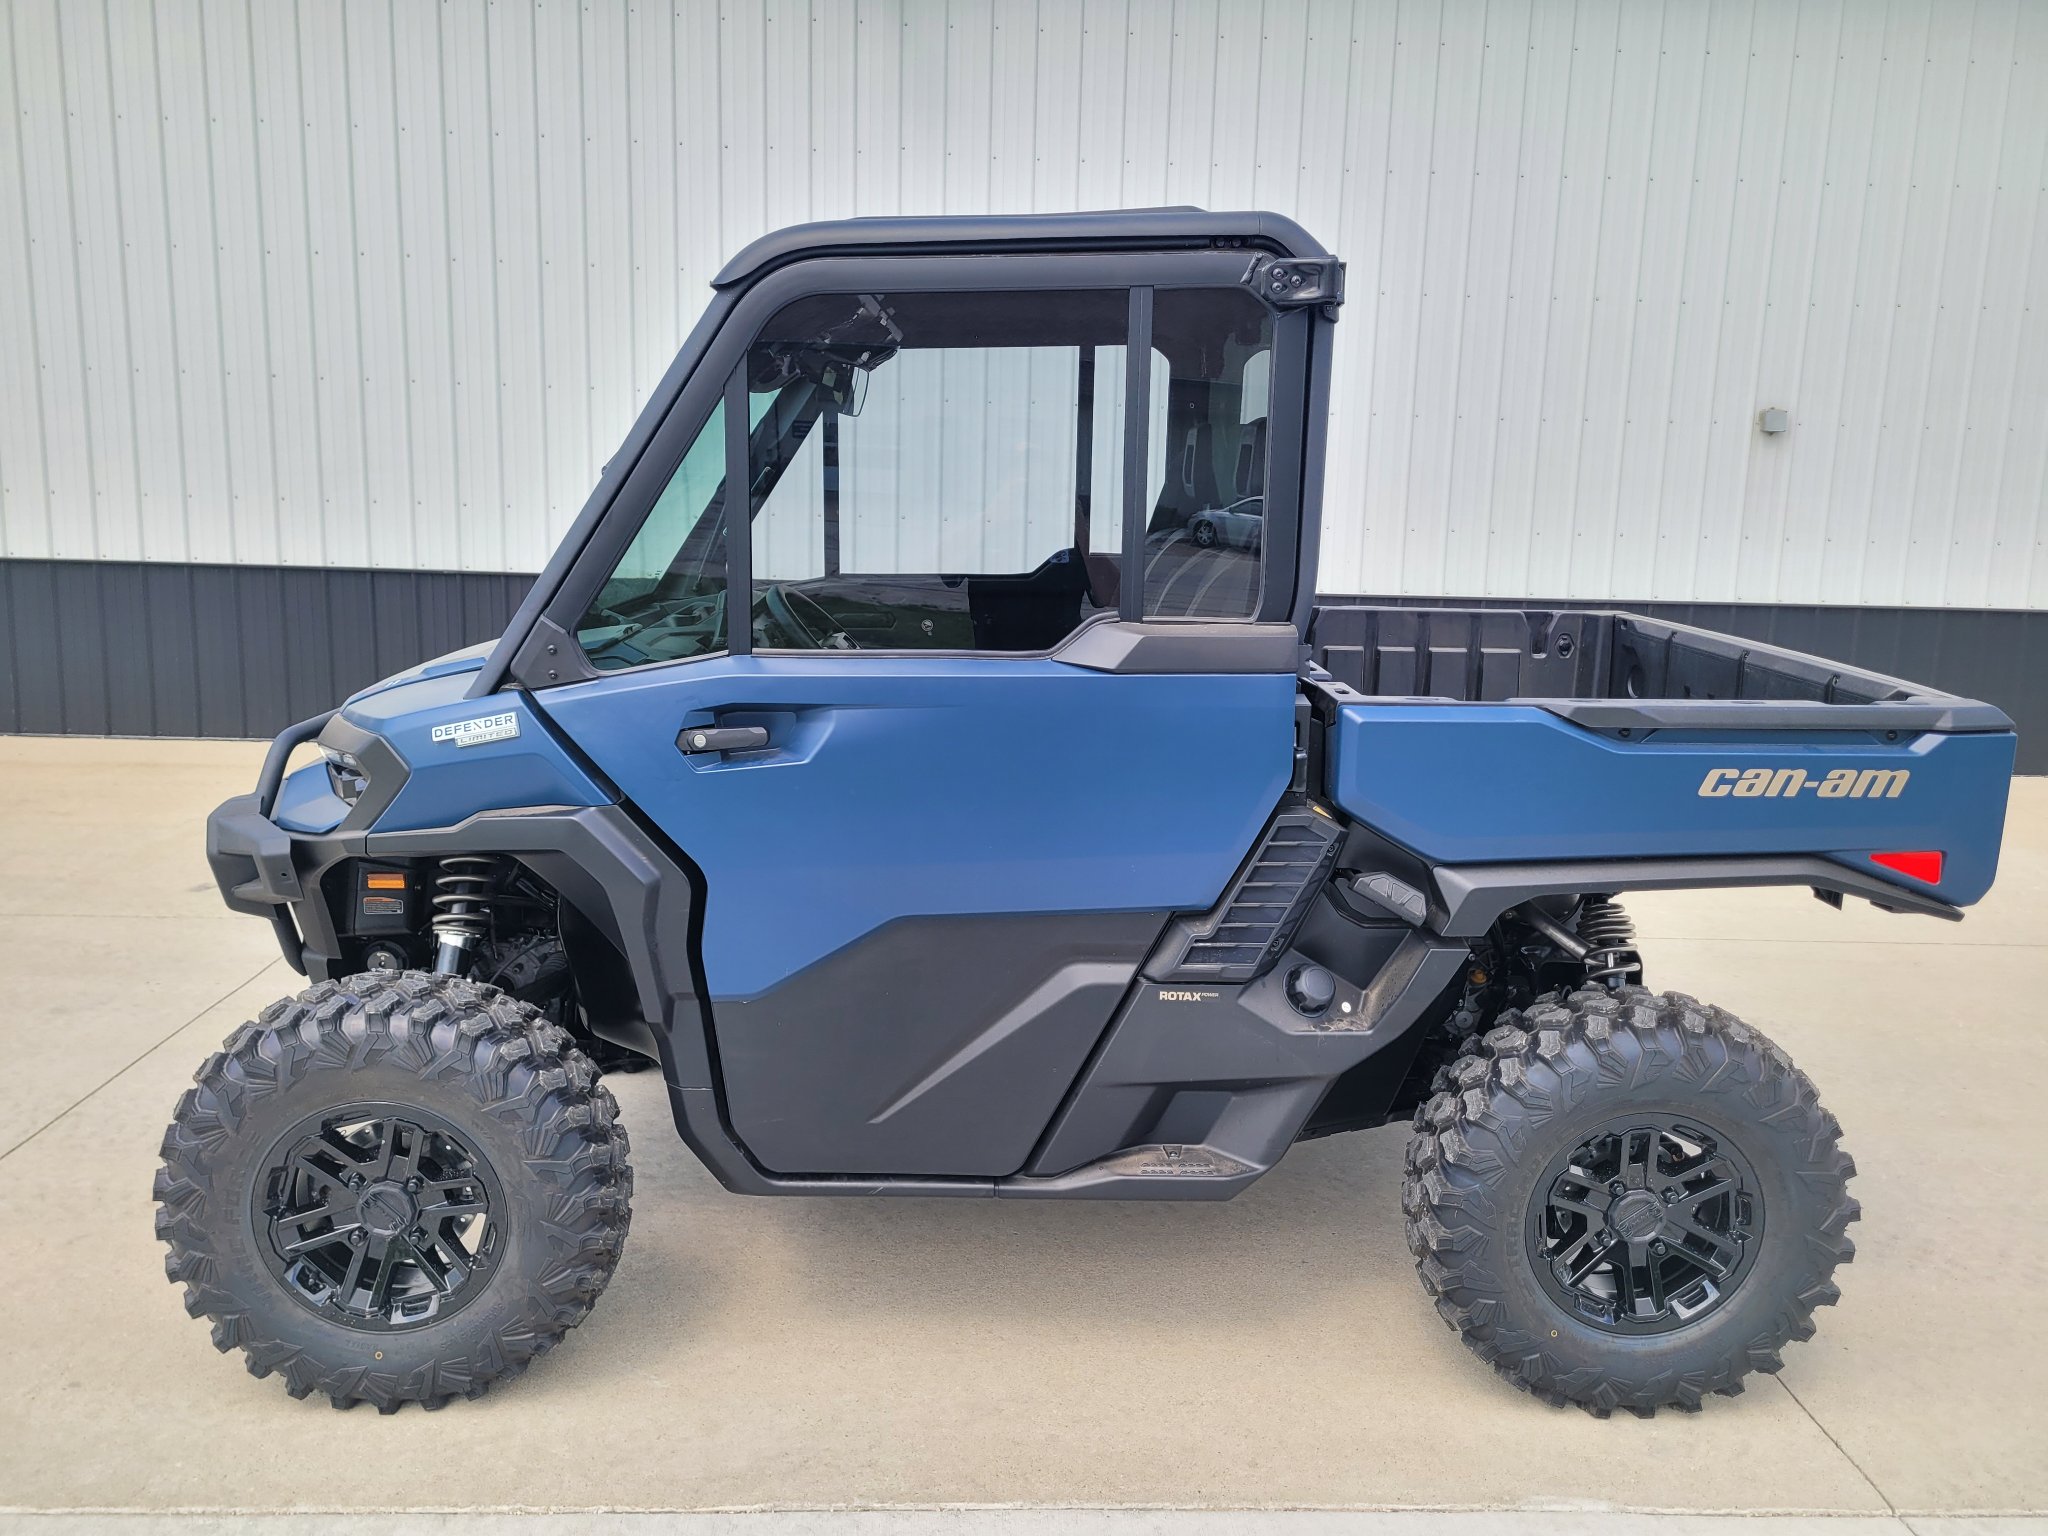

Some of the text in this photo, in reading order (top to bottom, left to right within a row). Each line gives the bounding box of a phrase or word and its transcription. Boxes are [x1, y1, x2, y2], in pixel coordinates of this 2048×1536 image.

[434, 715, 514, 738] DEFENDER
[1698, 768, 1910, 798] can-am
[1160, 991, 1201, 1001] ROTAX
